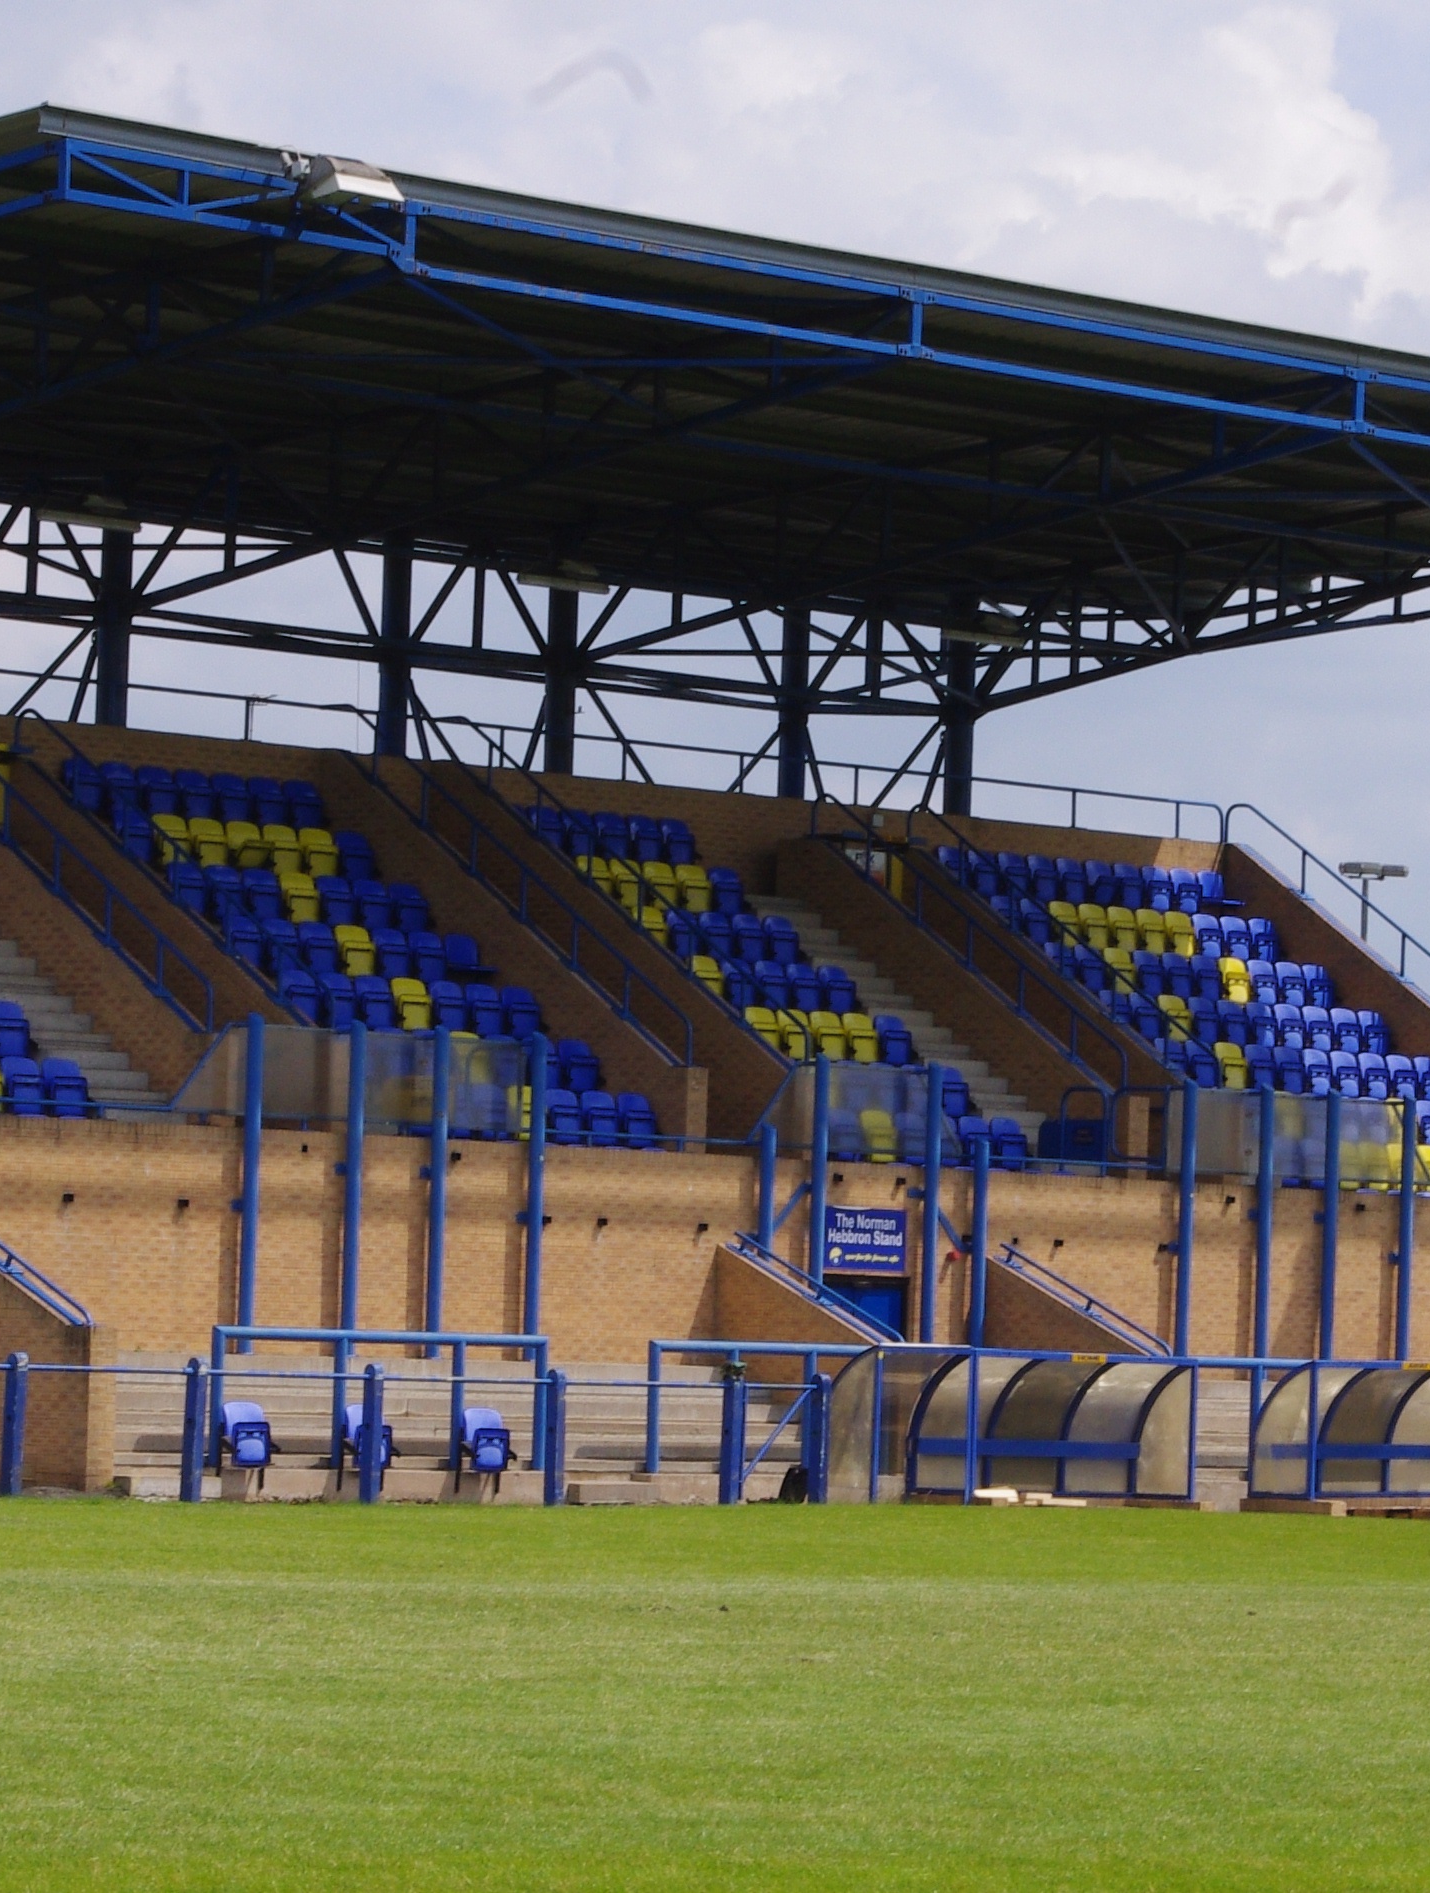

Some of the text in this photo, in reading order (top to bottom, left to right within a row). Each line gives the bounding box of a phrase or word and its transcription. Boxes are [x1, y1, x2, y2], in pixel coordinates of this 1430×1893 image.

[835, 1213, 896, 1230] The Norman
[828, 1228, 903, 1247] Hebbron Stand
